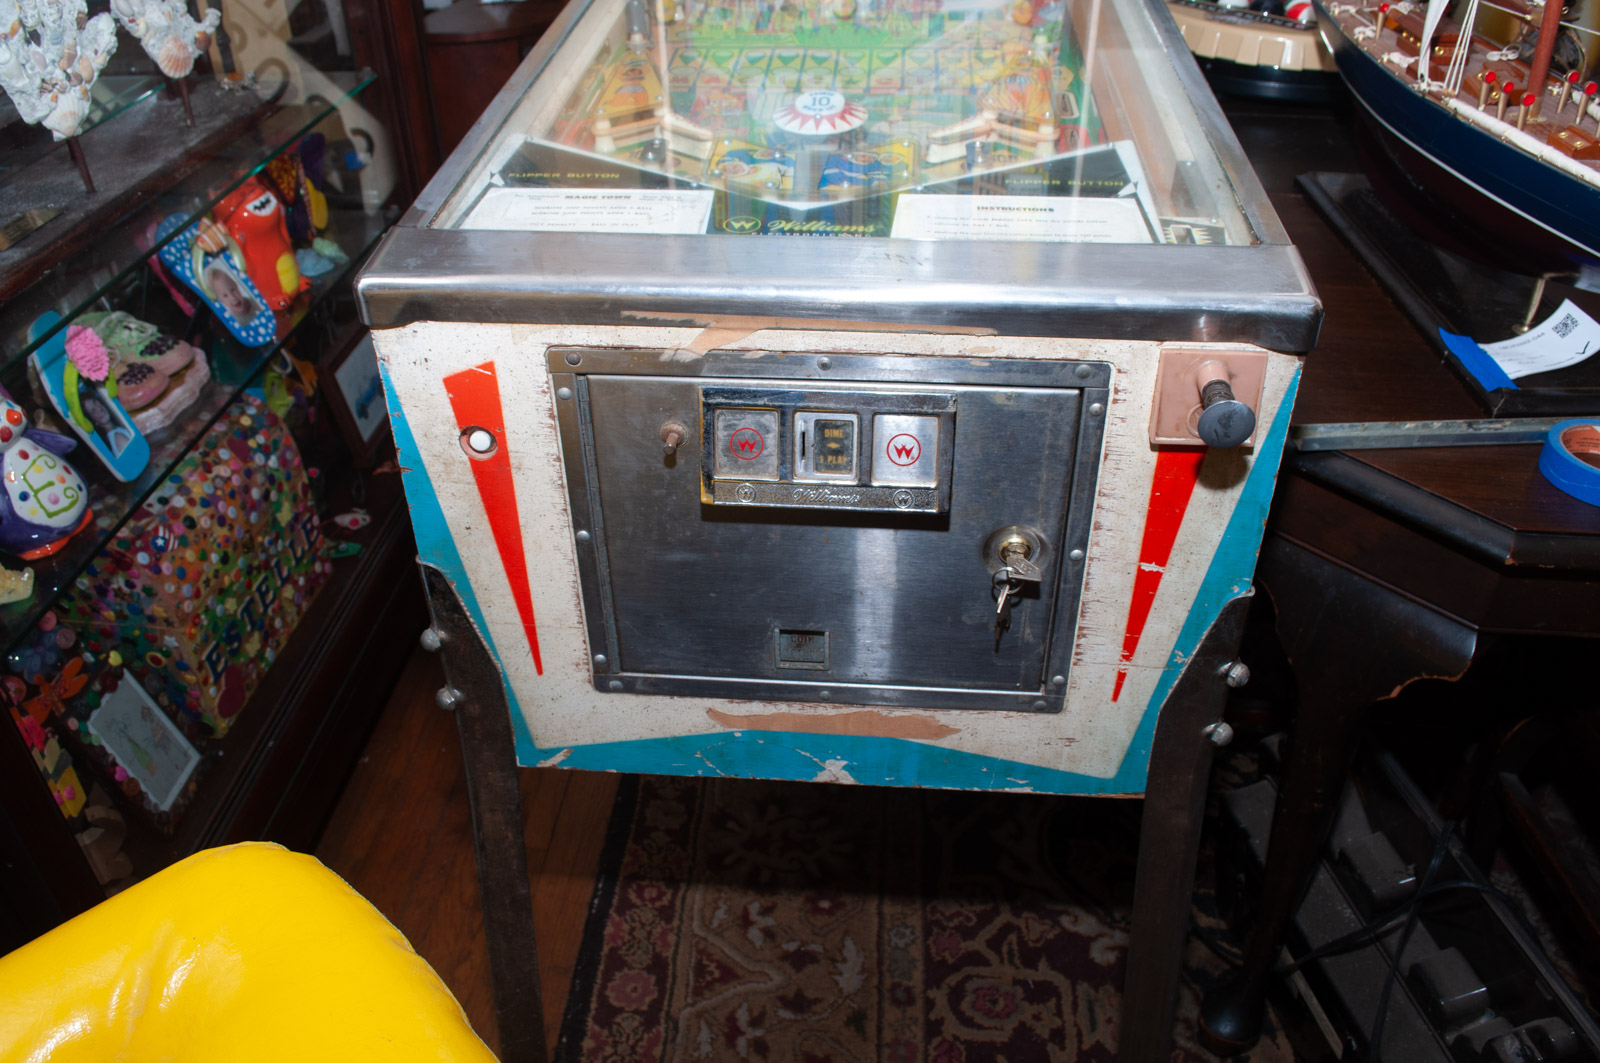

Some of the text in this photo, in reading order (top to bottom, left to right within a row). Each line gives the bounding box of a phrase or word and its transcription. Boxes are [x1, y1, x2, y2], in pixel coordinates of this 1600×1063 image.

[767, 219, 876, 233] Williams
[824, 428, 844, 438] DIME
[736, 438, 758, 454] W
[893, 444, 915, 460] W
[827, 455, 848, 465] PLAY
[202, 512, 321, 686] ESTELLE
